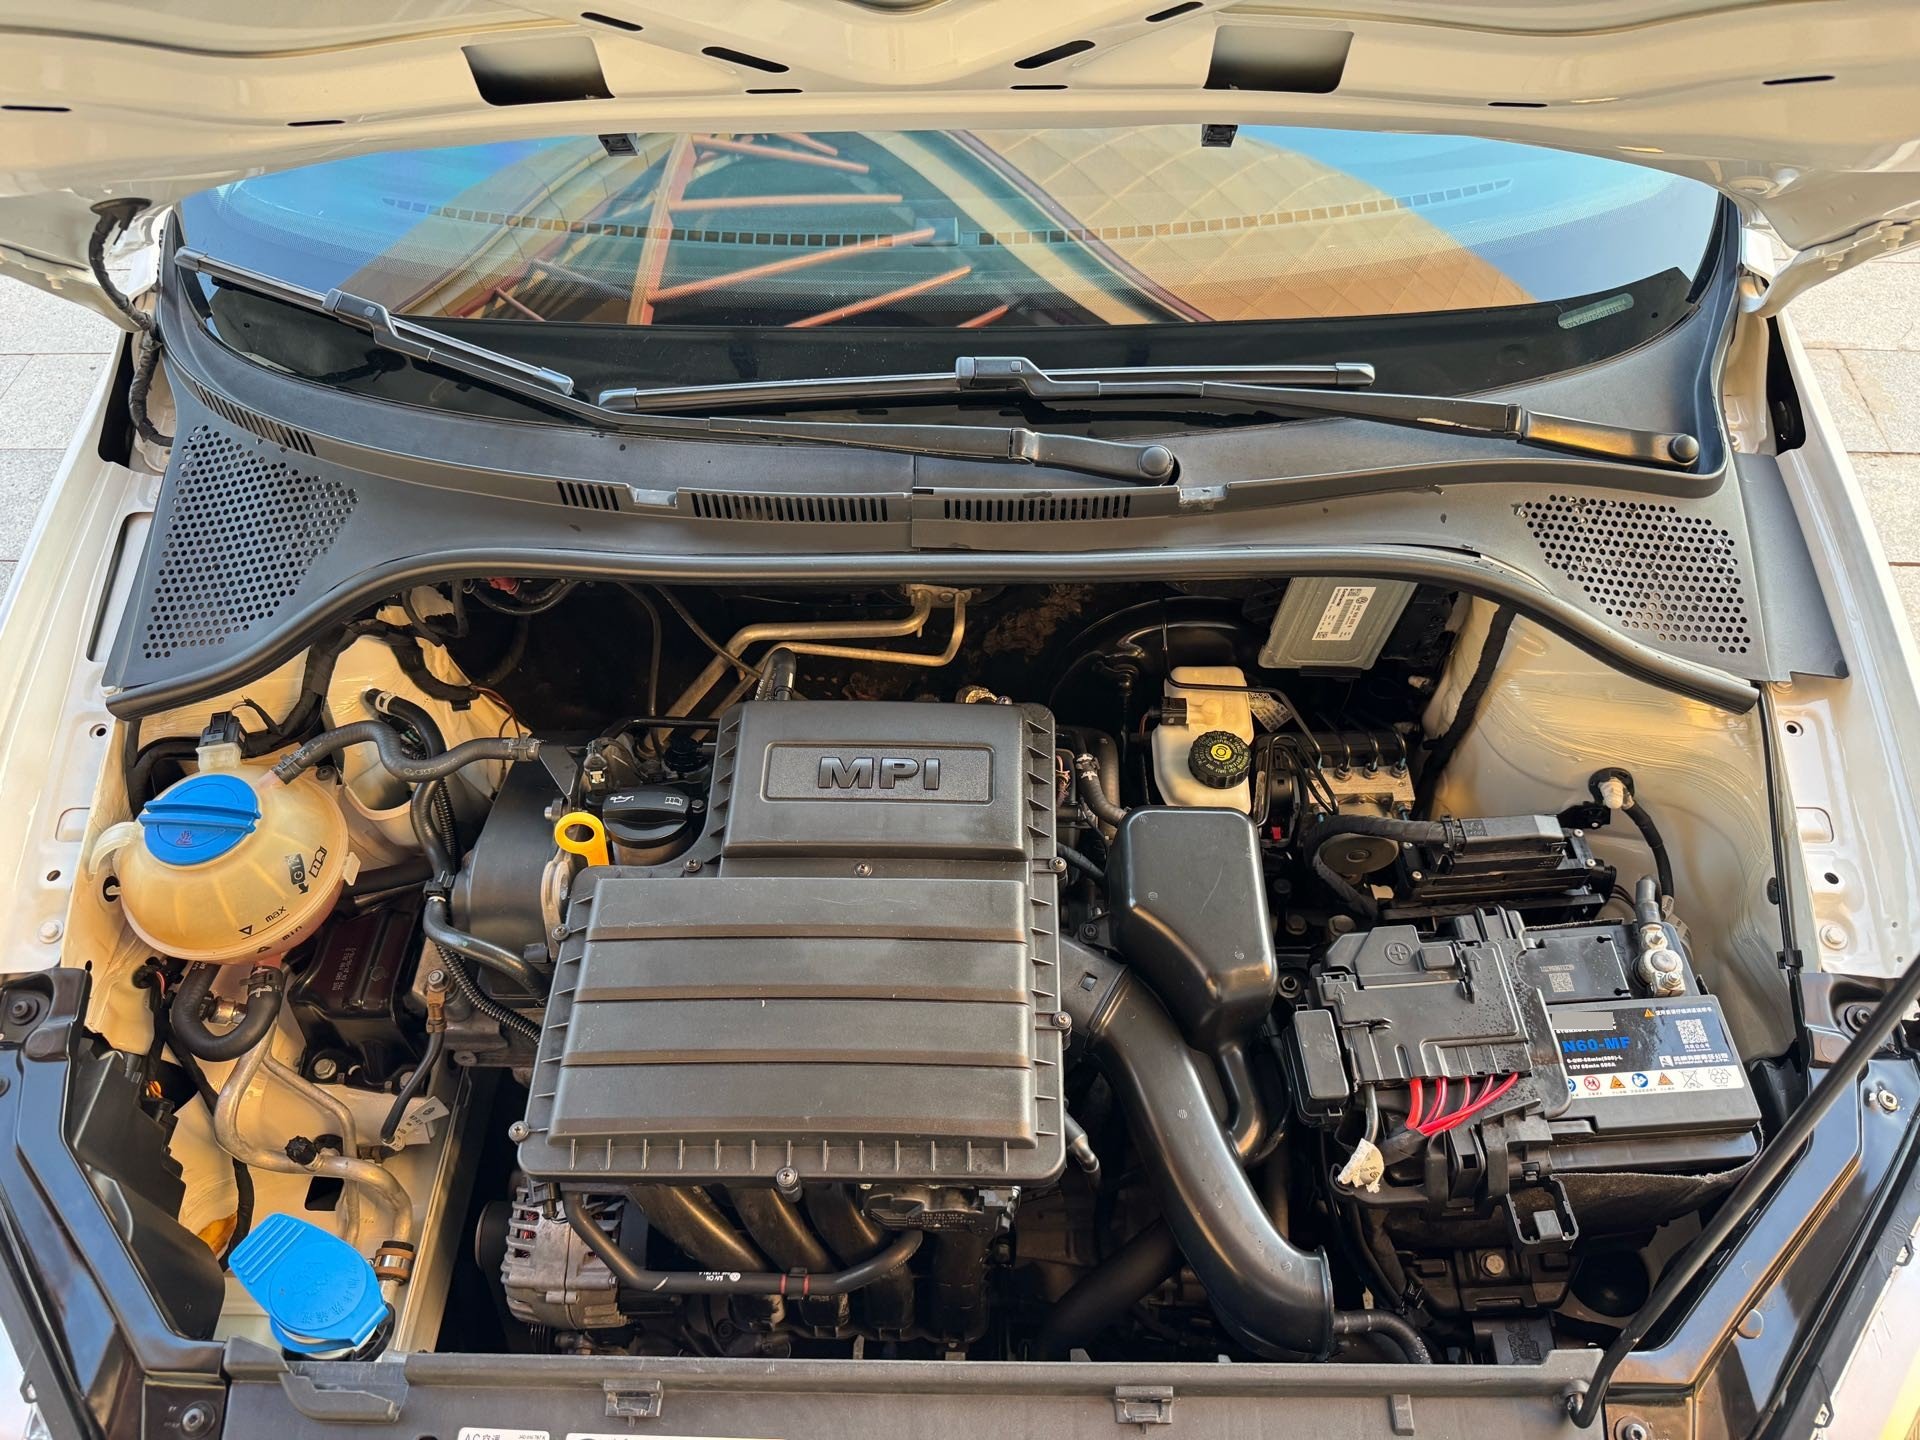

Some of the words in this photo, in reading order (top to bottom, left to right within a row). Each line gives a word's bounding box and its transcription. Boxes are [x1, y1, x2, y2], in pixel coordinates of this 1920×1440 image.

[818, 756, 940, 790] MPI
[265, 906, 287, 922] max
[282, 925, 302, 941] min
[1561, 1036, 1631, 1053] N60-MF
